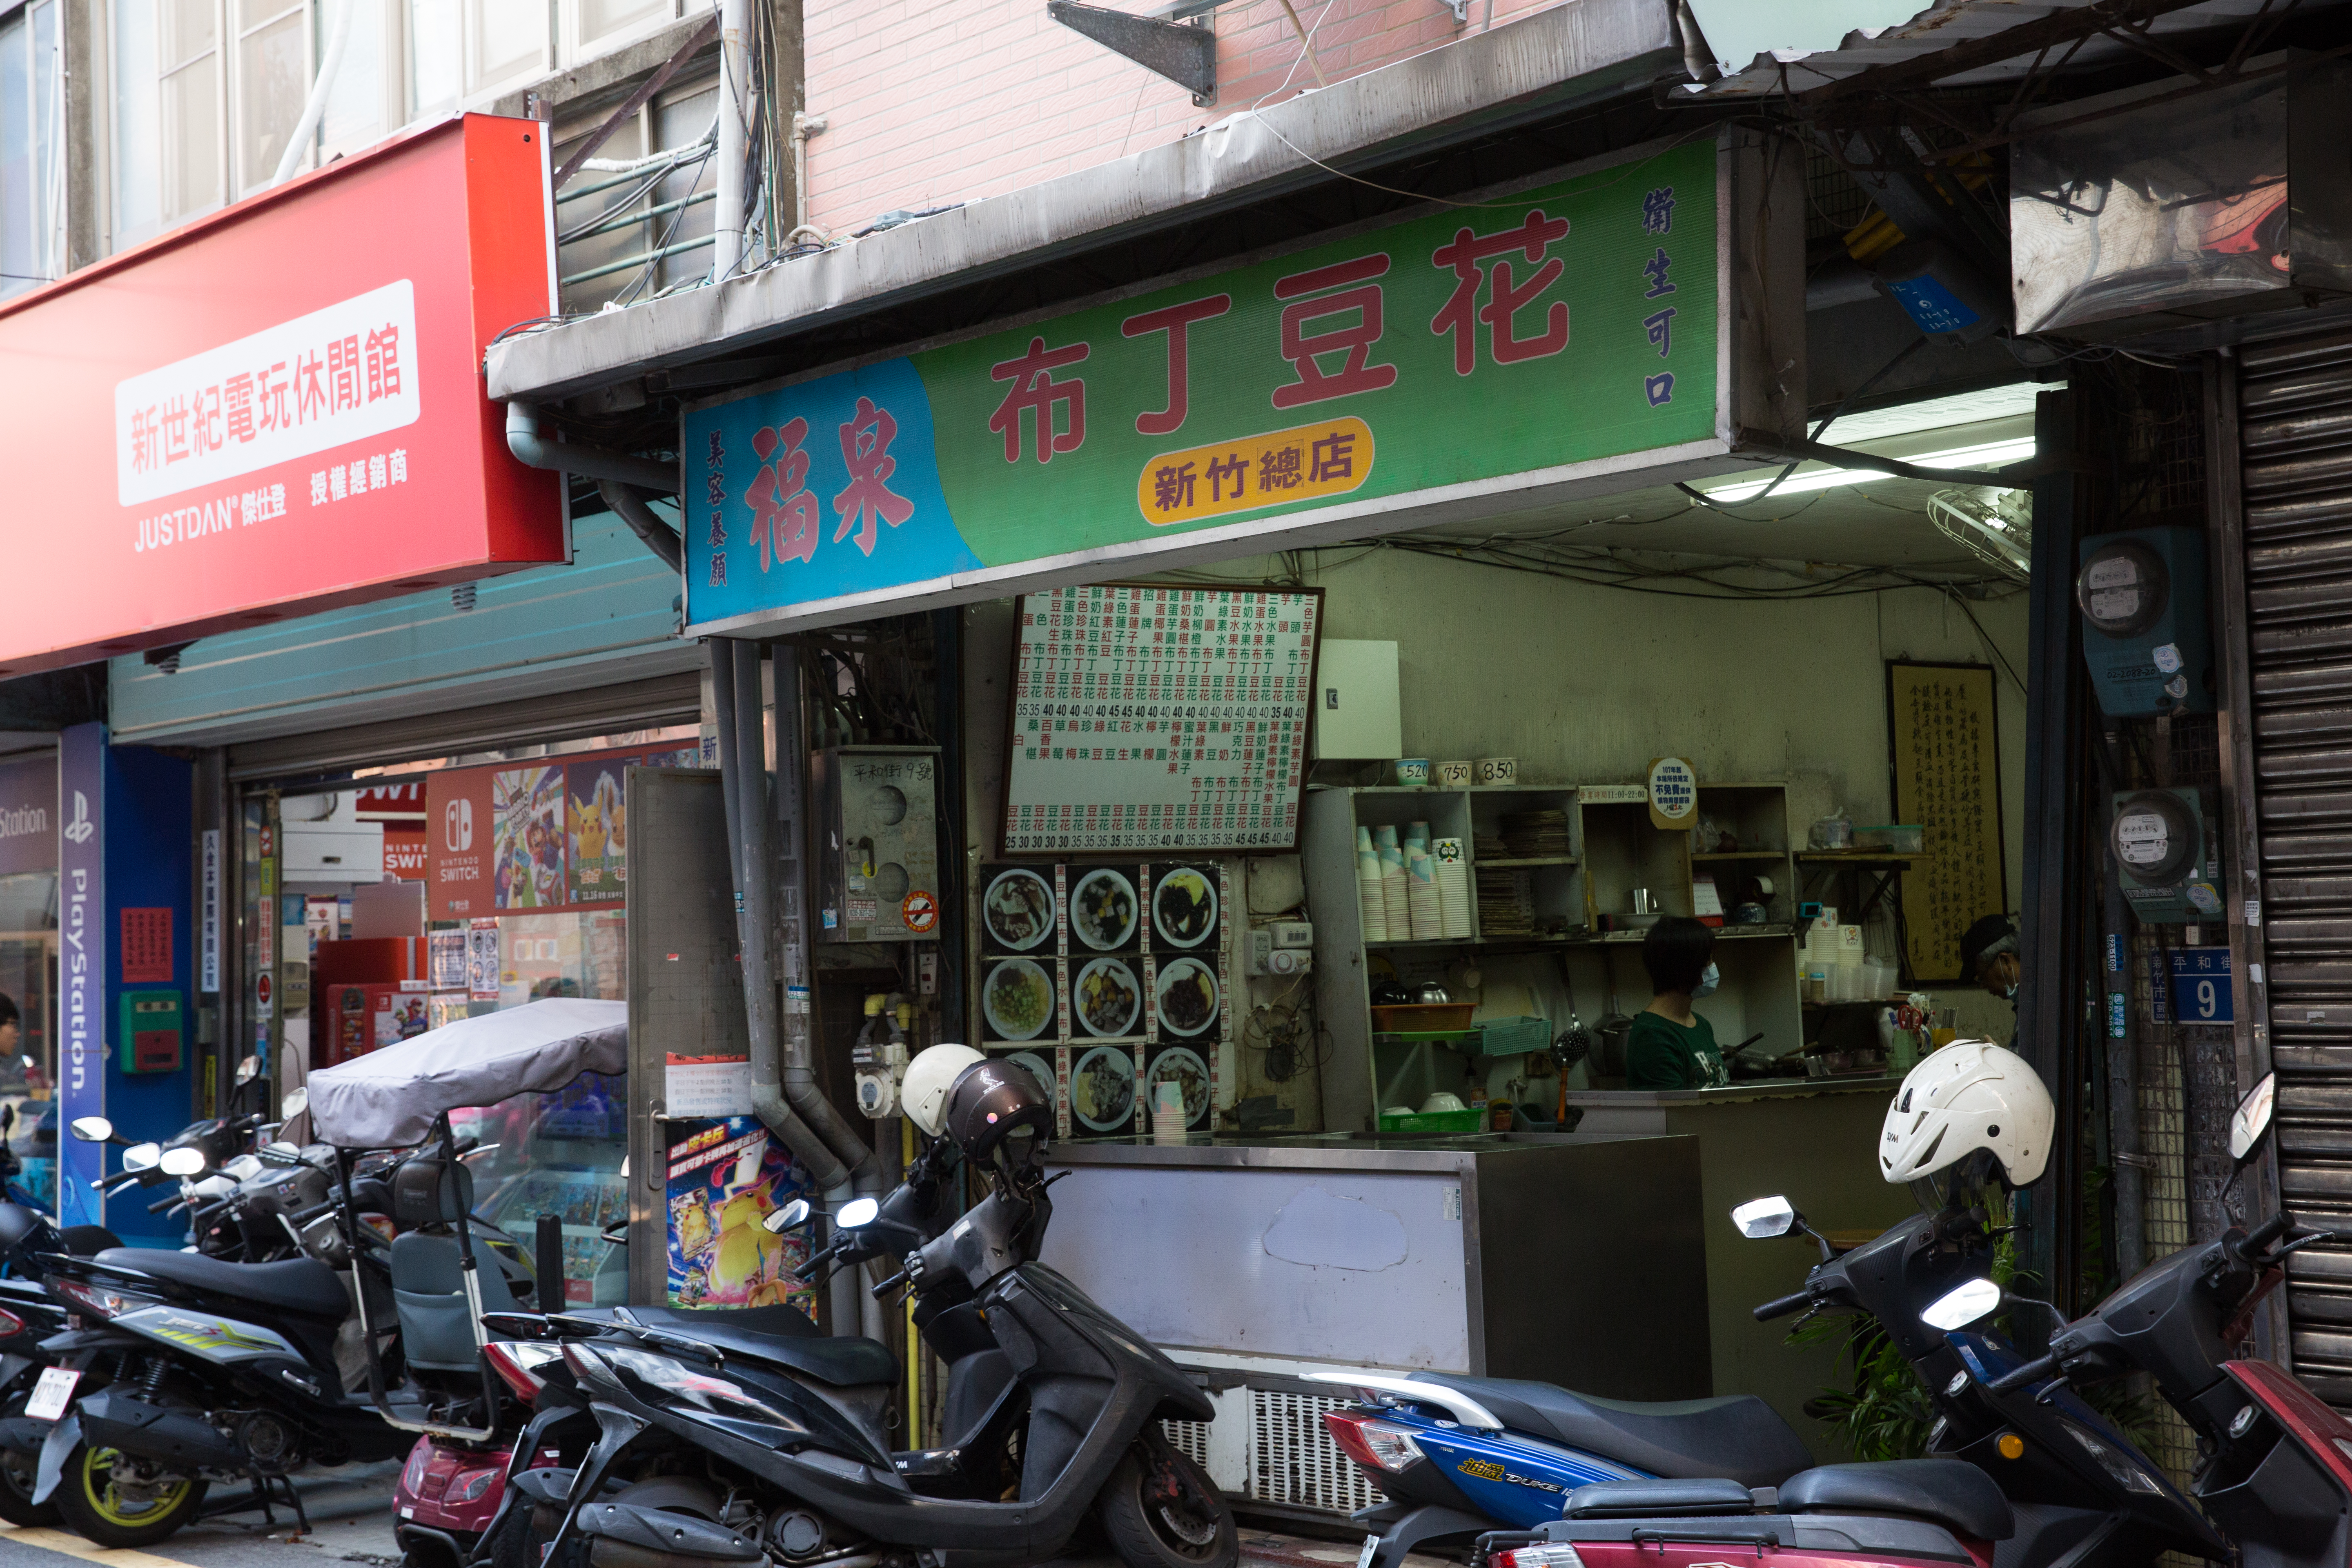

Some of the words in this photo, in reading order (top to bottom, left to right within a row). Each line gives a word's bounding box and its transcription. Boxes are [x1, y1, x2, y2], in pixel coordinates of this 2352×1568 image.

[1642, 186, 1677, 408] 衛生可口
[989, 208, 1571, 466] 布丁豆花
[130, 321, 401, 476] 新世紀電玩休閒館
[310, 449, 408, 506] 授權經銷商
[1154, 430, 1360, 512] 新竹總店
[745, 396, 916, 572] 福泉
[705, 430, 728, 589] 美容養顏
[1045, 588, 1062, 698] 黑豆花生布丁豆花
[1058, 587, 1076, 699] 雞蛋珍珠布丁豆花
[1071, 588, 1089, 698] 三色珍珠布丁豆花
[1084, 588, 1102, 699] 鮮奶紅豆布丁豆花
[1097, 588, 1115, 699] 葉綠素紅豆豆花
[1110, 589, 1128, 699] 三色蓮子布丁豆花
[1124, 589, 1140, 699] 雞蛋蓮子布丁豆花
[1136, 590, 1154, 700] 招牌布丁豆花
[1162, 590, 1179, 700] 雞蛋芋圓布丁豆花
[1200, 592, 1217, 700] 芋圓布丁豆花
[1212, 592, 1230, 701] 葉綠素水果豆花
[1225, 592, 1242, 701] 黑豆水果布丁豆花
[1237, 593, 1254, 701] 鮮奶水果布丁豆花
[1249, 593, 1266, 701] 雞蛋水果布丁豆花
[1261, 594, 1278, 701] 三色水果布丁豆花
[1273, 594, 1291, 701] 芋頭豆花
[1285, 595, 1303, 701] 芋頭布丁豆花
[1296, 595, 1314, 701] 三色芋圓布丁豆花
[1018, 704, 1027, 715] 35
[1029, 704, 1039, 716] 35
[1043, 704, 1054, 716] 40
[1056, 704, 1066, 716] 40
[1070, 705, 1080, 717] 40
[1083, 705, 1093, 717] 40
[1096, 705, 1106, 717] 40
[1109, 705, 1119, 717] 45
[1122, 706, 1132, 717] 45
[1135, 706, 1145, 717] 40
[1148, 706, 1158, 717] 40
[1160, 706, 1170, 717] 40
[1173, 706, 1182, 717] 40
[1186, 707, 1195, 718] 40
[1198, 707, 1208, 718] 40
[1210, 706, 1220, 718] 40
[1223, 707, 1232, 718] 40
[1235, 707, 1245, 718] 40
[1247, 707, 1256, 718] 40
[1259, 707, 1268, 718] 40
[1271, 707, 1281, 718] 35
[1283, 707, 1292, 718] 40
[1295, 708, 1304, 718] 40
[702, 736, 717, 769] 新
[853, 762, 933, 783] 平和街9號
[1033, 720, 1052, 831] 百香果豆花
[1047, 720, 1066, 831] 草莓豆花
[1060, 720, 1078, 831] 烏梅豆花
[1073, 720, 1092, 831] 珍珠豆花
[1086, 721, 1105, 830] 綠豆豆花
[1099, 721, 1118, 830] 紅豆豆花
[1112, 721, 1131, 830] 花生豆花
[1125, 721, 1143, 830] 水果豆花
[1150, 721, 1169, 830] 芋圓豆花
[1175, 721, 1194, 829] 蜜汁蓮子豆花
[1187, 722, 1207, 829] 葉綠素布丁豆花
[1200, 721, 1218, 829] 黑豆布丁豆花
[1212, 722, 1231, 829] 鮮奶布丁豆花
[1225, 722, 1244, 828] 巧克力布丁豆花
[1237, 722, 1255, 828] 黑豆蓮子布丁豆花
[1249, 722, 1267, 828] 鮮奶蓮子布丁豆花
[1285, 721, 1303, 827] 葉綠素芋圓豆花
[1407, 764, 1428, 777] 520
[1444, 766, 1468, 781] 750
[1483, 762, 1513, 780] 850
[1006, 734, 1023, 831] 白豆花
[1005, 835, 1015, 848] 25
[1019, 836, 1029, 848] 30
[1032, 836, 1042, 848] 30
[1045, 836, 1055, 847] 30
[1058, 836, 1069, 847] 30
[1071, 835, 1081, 847] 35
[1085, 835, 1094, 847] 35
[1098, 835, 1107, 847] 35
[1110, 835, 1120, 846] 35
[1123, 835, 1134, 846] 35
[1135, 835, 1145, 846] 35
[1148, 834, 1158, 846] 35
[1160, 835, 1170, 846] 40
[1173, 834, 1183, 846] 40
[1185, 834, 1195, 846] 35
[1197, 834, 1207, 845] 35
[1210, 833, 1220, 845] 35
[1222, 834, 1232, 845] 35
[1235, 833, 1245, 845] 45
[1247, 833, 1257, 845] 45
[1259, 833, 1269, 844] 45
[1271, 833, 1281, 844] 40
[1283, 832, 1294, 844] 40
[440, 855, 479, 867] NINTENDO
[440, 865, 479, 883] SWITCH
[1056, 865, 1067, 956] 黑豆花生布丁
[2173, 955, 2231, 971] 平和街
[66, 868, 87, 1091] PlayStation
[1057, 958, 1068, 1045] 三色水果布丁
[2197, 980, 2216, 1018] 9
[1057, 1048, 1068, 1136] 葉綠素水果布丁
[1134, 1043, 1144, 1132] 招牌布丁
[1887, 1132, 1899, 1143] SYM
[1457, 1457, 1505, 1482] 迪爵
[1505, 1472, 1564, 1494] DUKE
